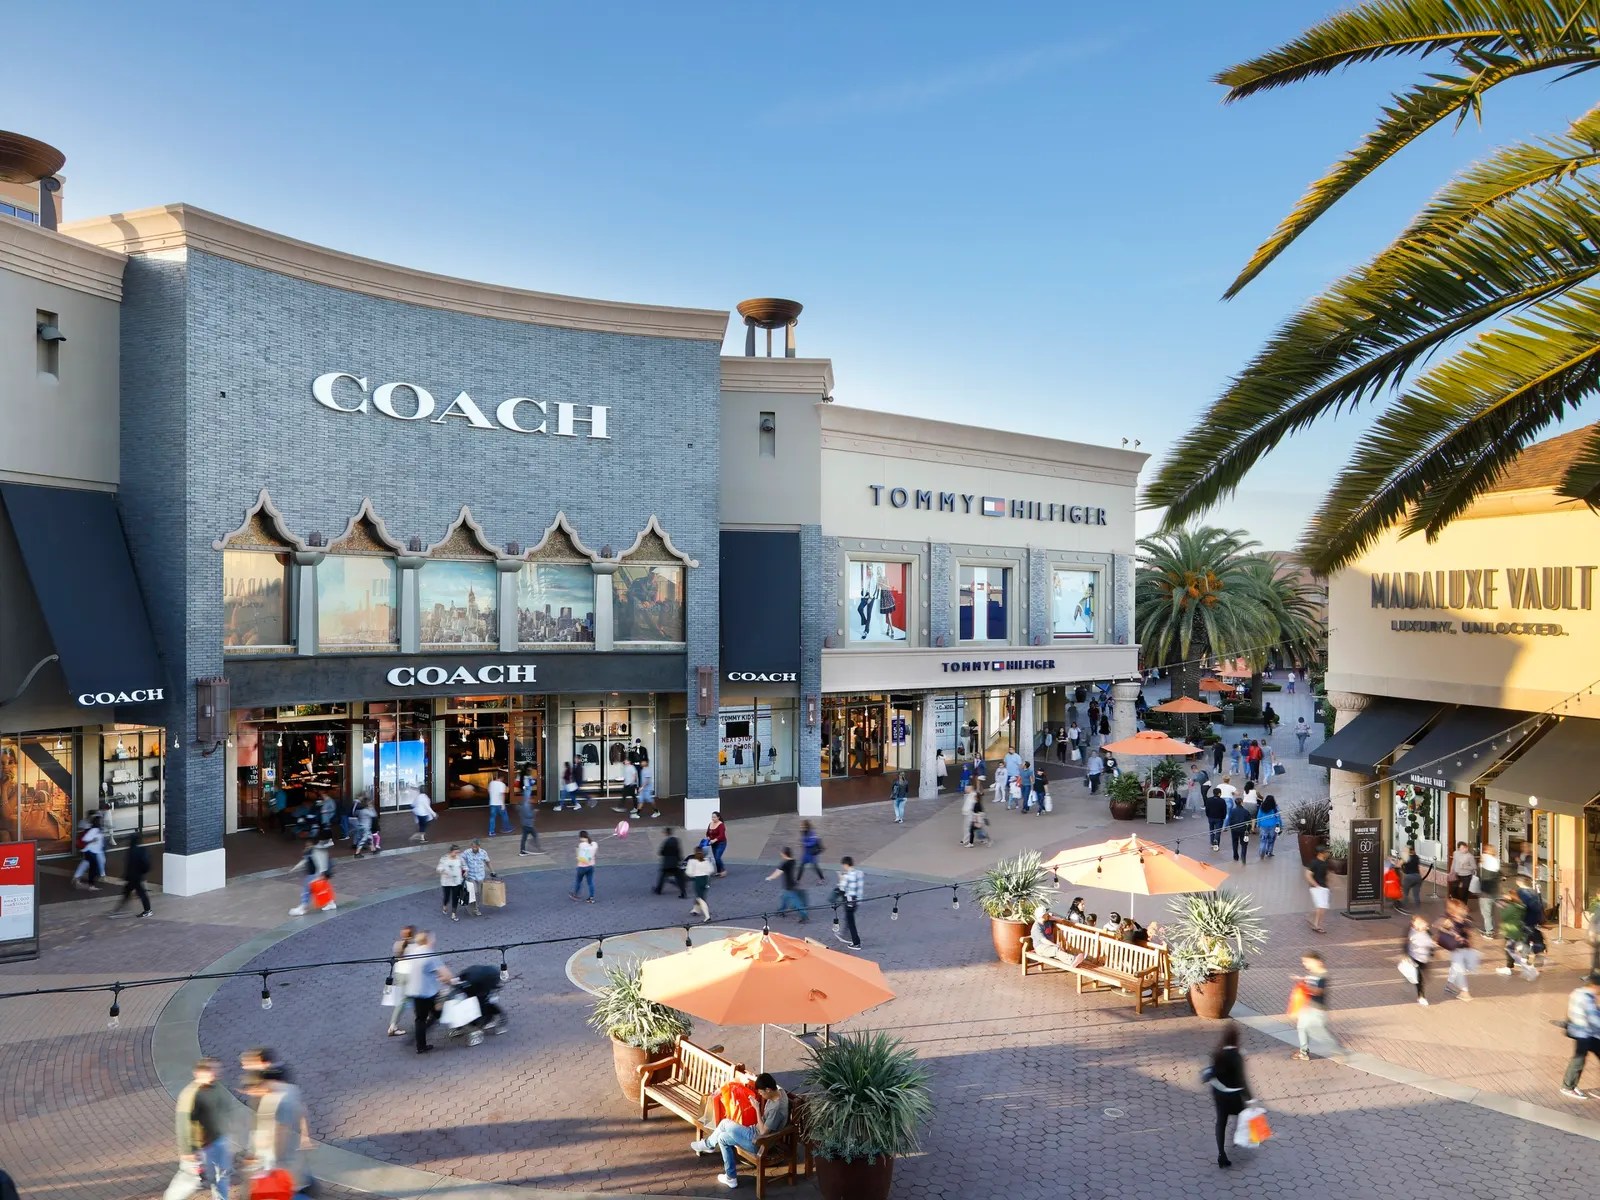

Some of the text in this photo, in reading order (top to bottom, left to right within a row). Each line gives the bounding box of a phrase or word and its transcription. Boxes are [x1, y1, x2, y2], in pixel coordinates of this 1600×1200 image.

[312, 372, 611, 439] COACH
[870, 484, 1107, 526] TOMMY HILFIGER
[1371, 565, 1598, 610] MADALUXE VAULT
[387, 664, 537, 687] COACH
[728, 672, 797, 682] COACH
[942, 660, 1055, 672] TOMMY HILFIGER
[78, 688, 164, 706] COACH
